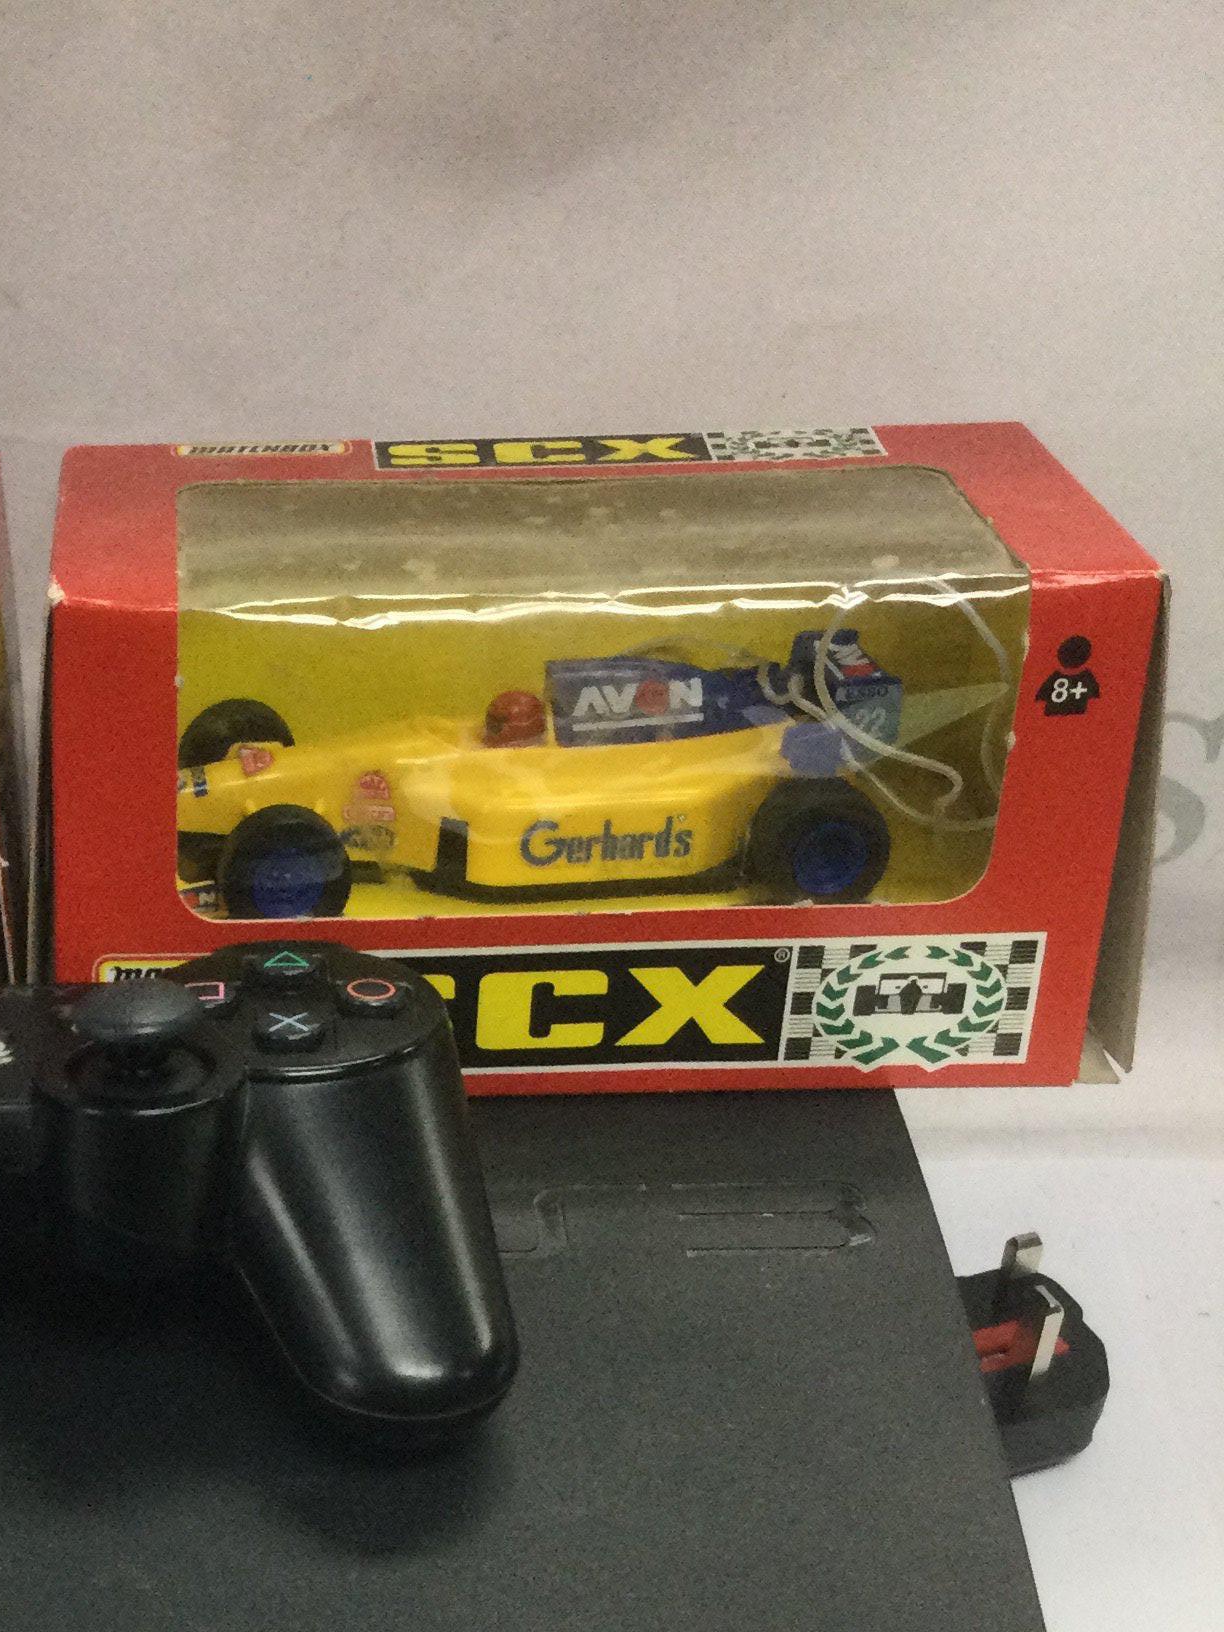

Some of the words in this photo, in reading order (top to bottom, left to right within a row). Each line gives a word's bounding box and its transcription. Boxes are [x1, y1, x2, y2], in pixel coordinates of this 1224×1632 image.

[388, 438, 695, 465] SCX
[573, 677, 703, 717] AVON
[1051, 678, 1087, 704] 8+
[424, 964, 766, 1051] CX
